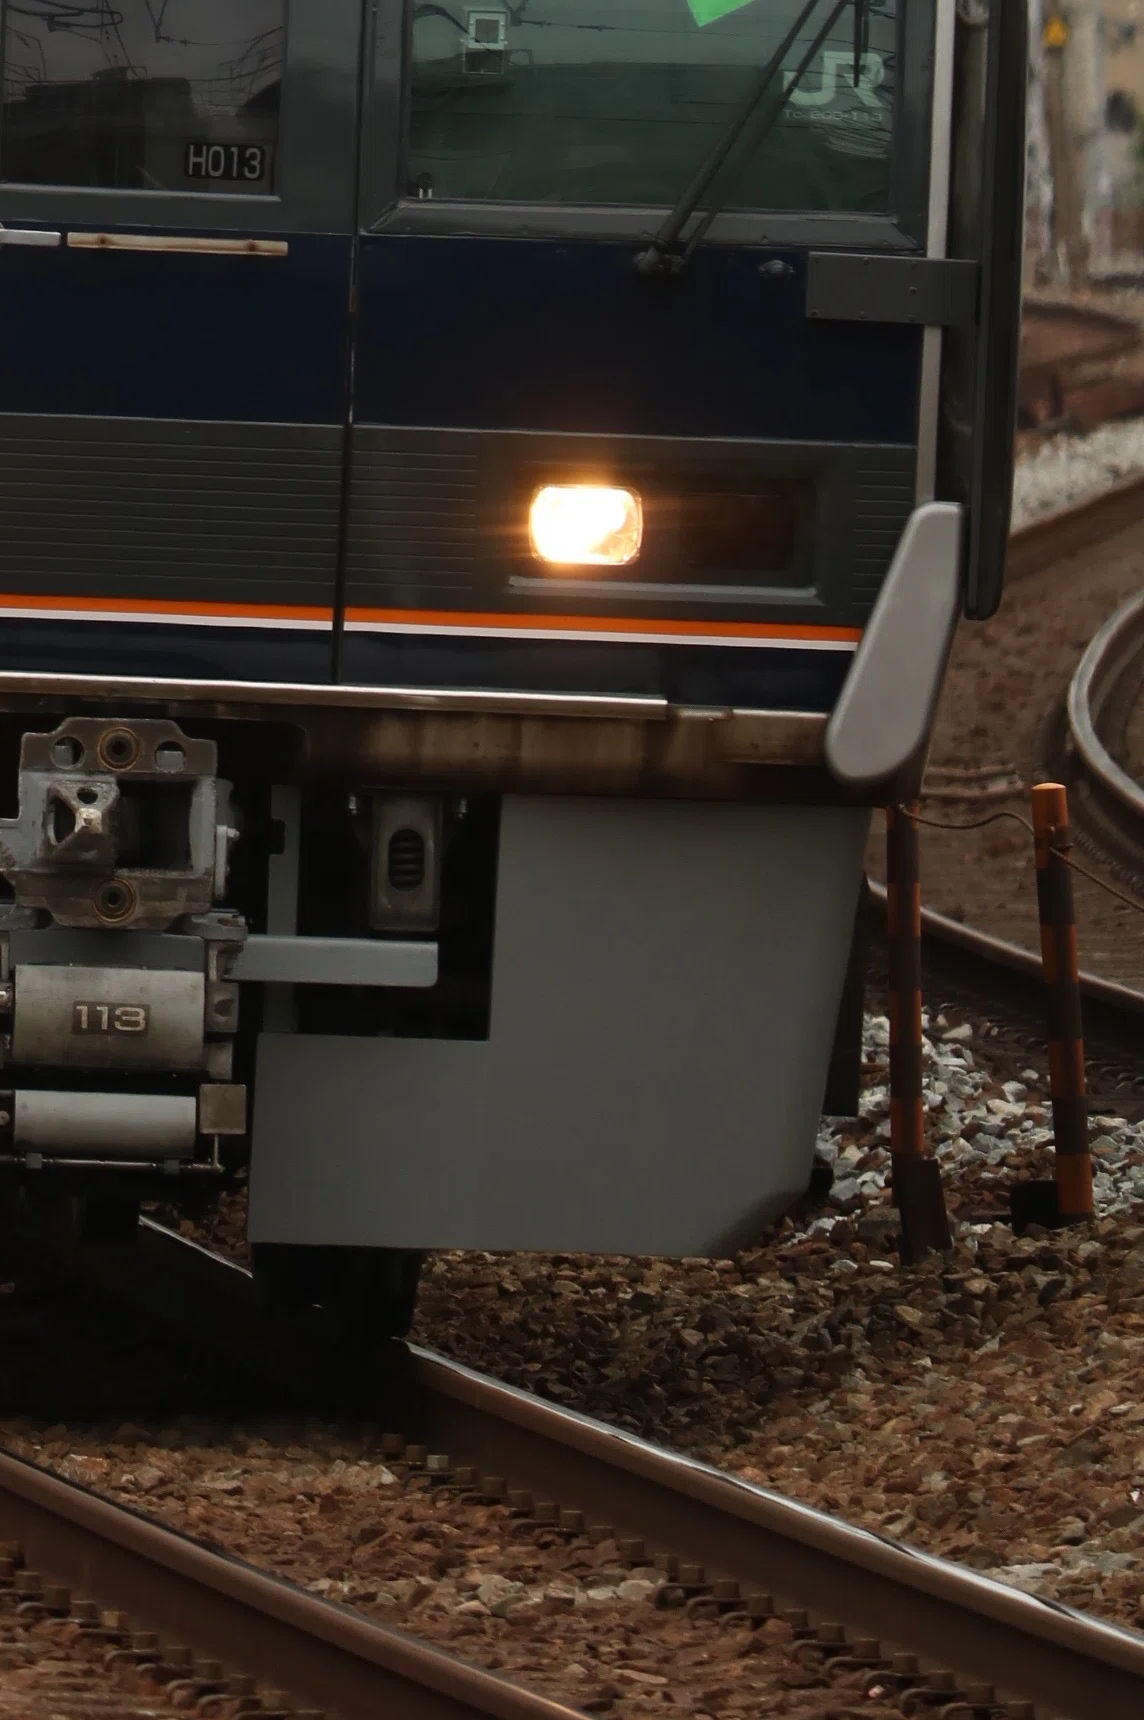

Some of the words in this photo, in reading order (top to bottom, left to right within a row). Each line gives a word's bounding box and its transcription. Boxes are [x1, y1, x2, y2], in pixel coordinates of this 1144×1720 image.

[783, 51, 888, 107] JR
[188, 144, 261, 179] H013
[76, 1005, 146, 1031] 113
